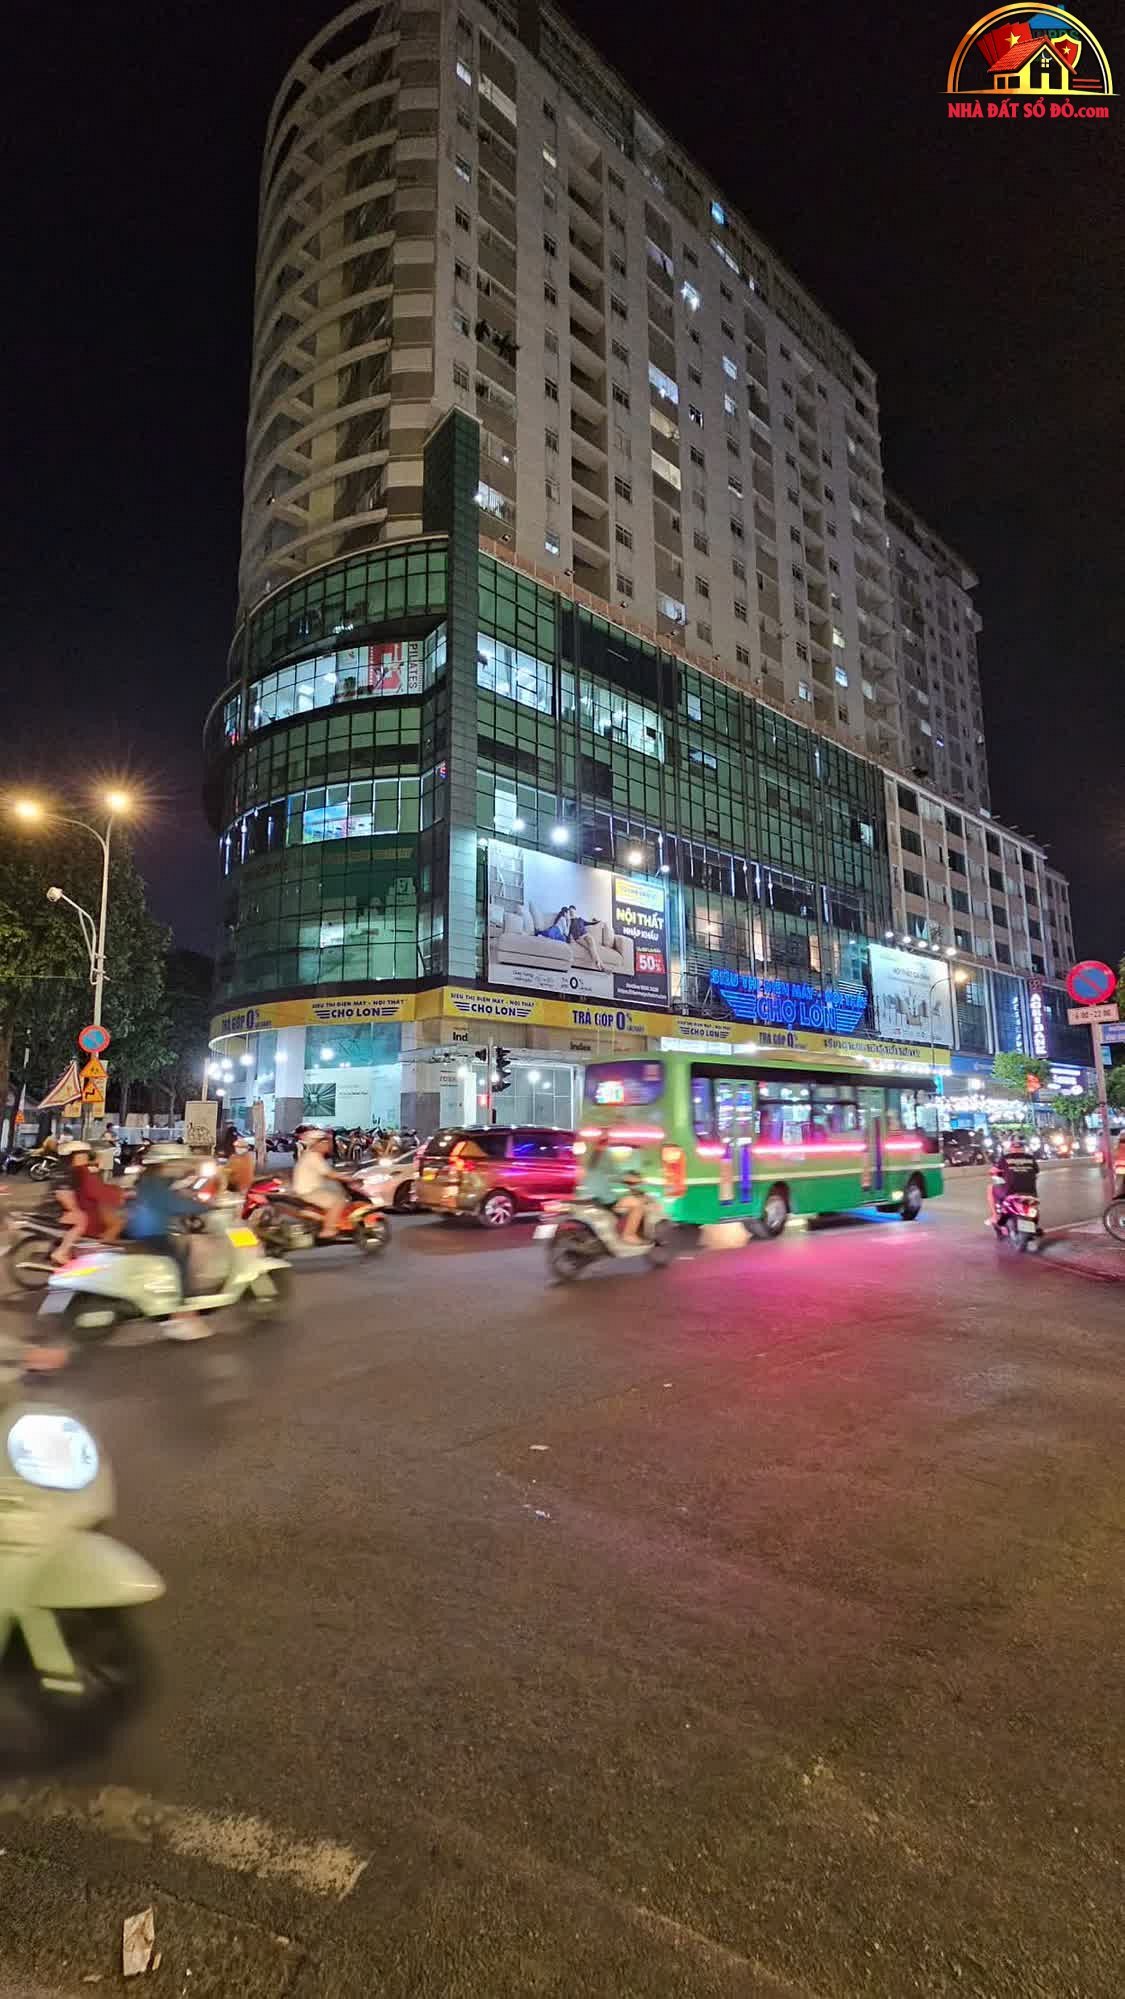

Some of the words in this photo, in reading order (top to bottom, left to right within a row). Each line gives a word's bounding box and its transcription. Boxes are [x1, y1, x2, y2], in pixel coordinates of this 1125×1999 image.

[408, 643, 418, 689] PILATES
[616, 907, 636, 925] NỘI
[637, 911, 664, 930] THẤT
